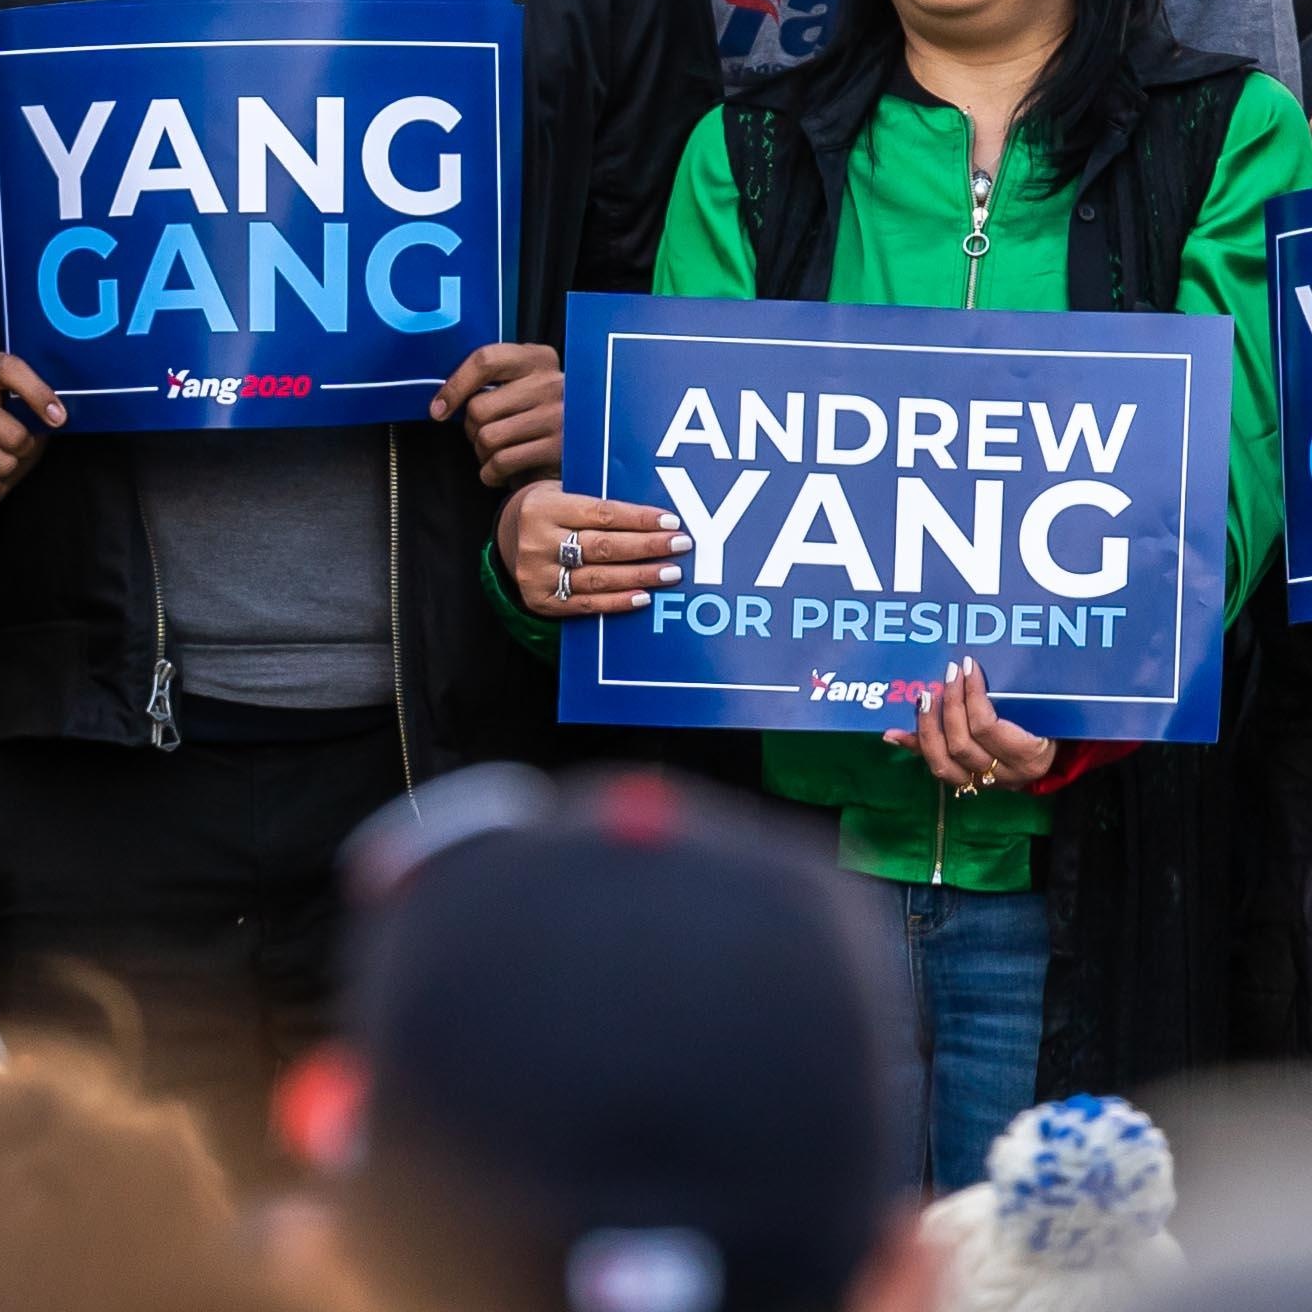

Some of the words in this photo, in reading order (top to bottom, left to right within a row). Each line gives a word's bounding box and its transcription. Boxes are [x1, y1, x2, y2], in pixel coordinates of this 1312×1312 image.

[19, 94, 464, 221] YANG
[37, 220, 464, 340] GANG
[654, 386, 1138, 474] ANDREW
[654, 465, 1133, 599] YANG
[652, 591, 773, 639] FOR
[791, 598, 1128, 649] PRESIDENT
